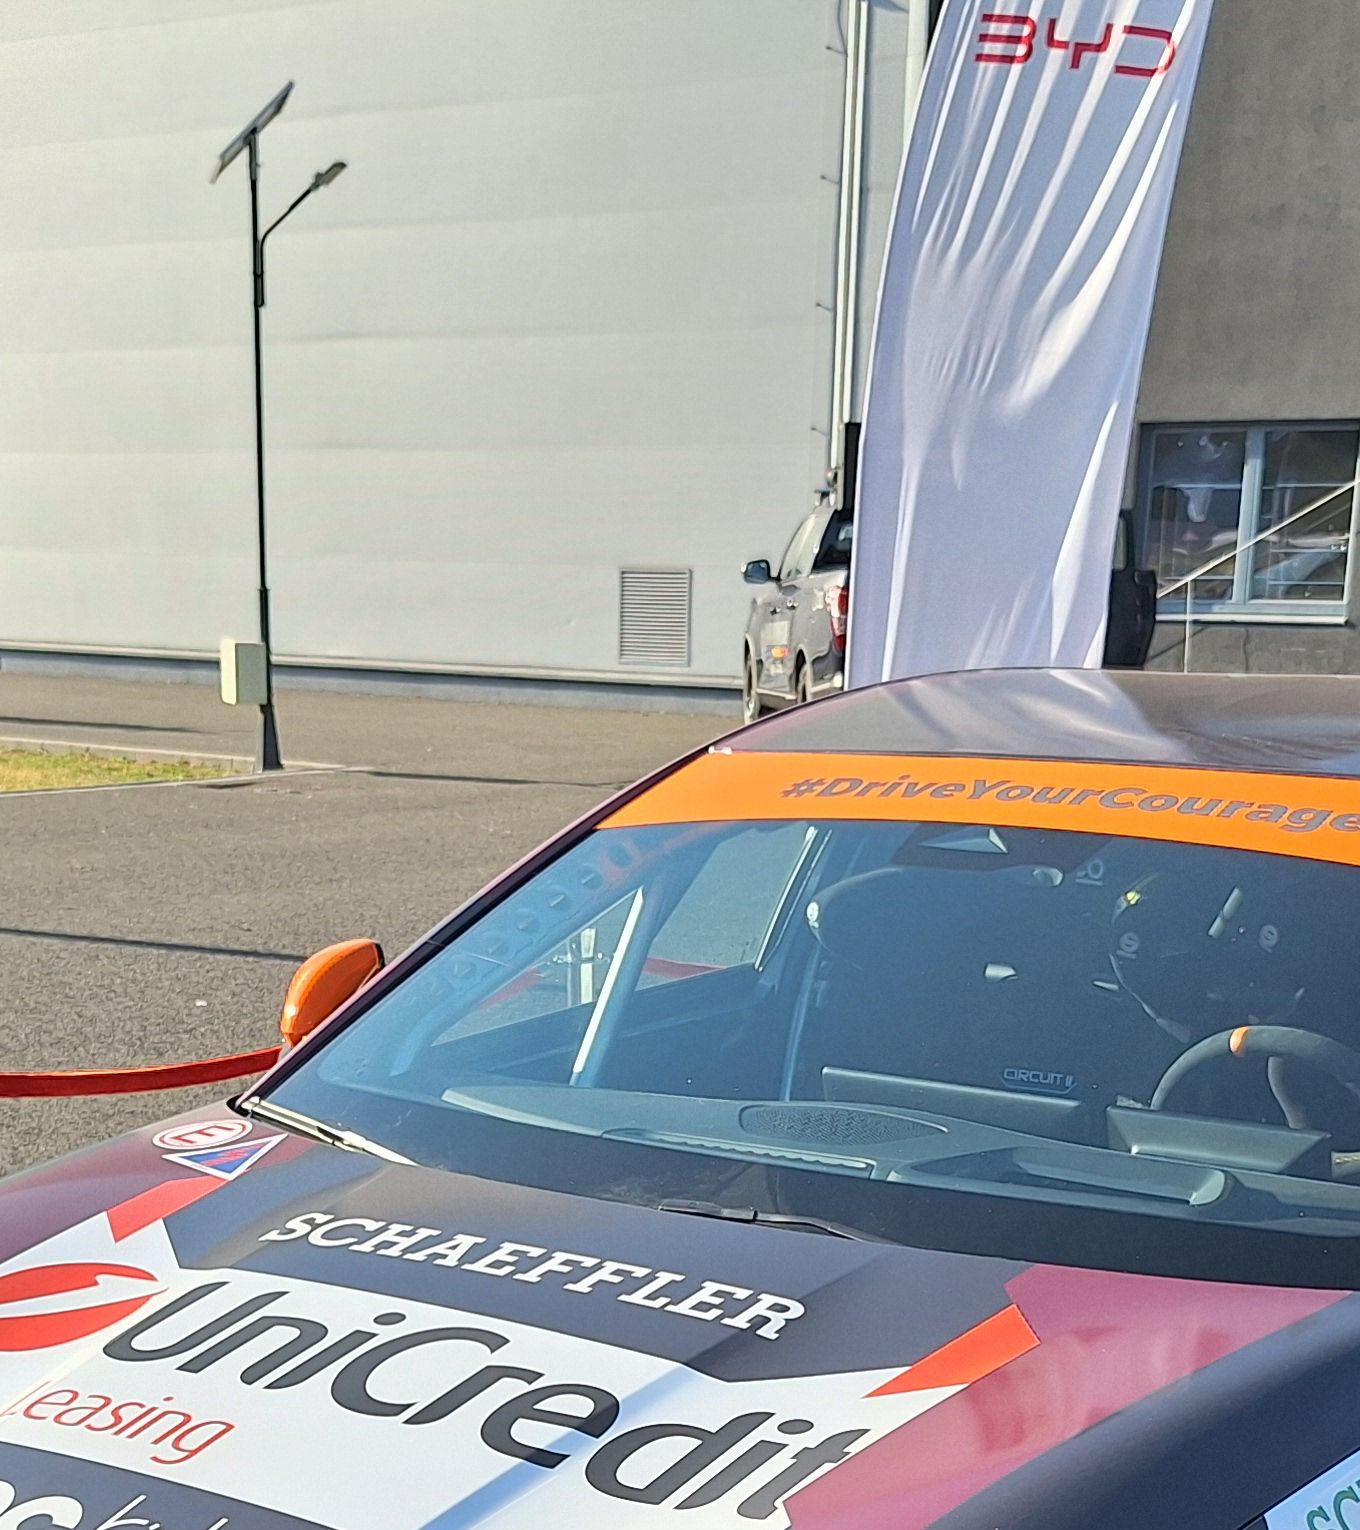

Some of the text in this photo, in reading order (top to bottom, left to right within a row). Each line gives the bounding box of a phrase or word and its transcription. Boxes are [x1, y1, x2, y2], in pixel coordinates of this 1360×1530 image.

[975, 13, 1176, 78] BYD
[258, 1210, 807, 1341] SCHAEFFLER
[0, 1379, 236, 1465] Leasing
[103, 1280, 871, 1520] UniCredit
